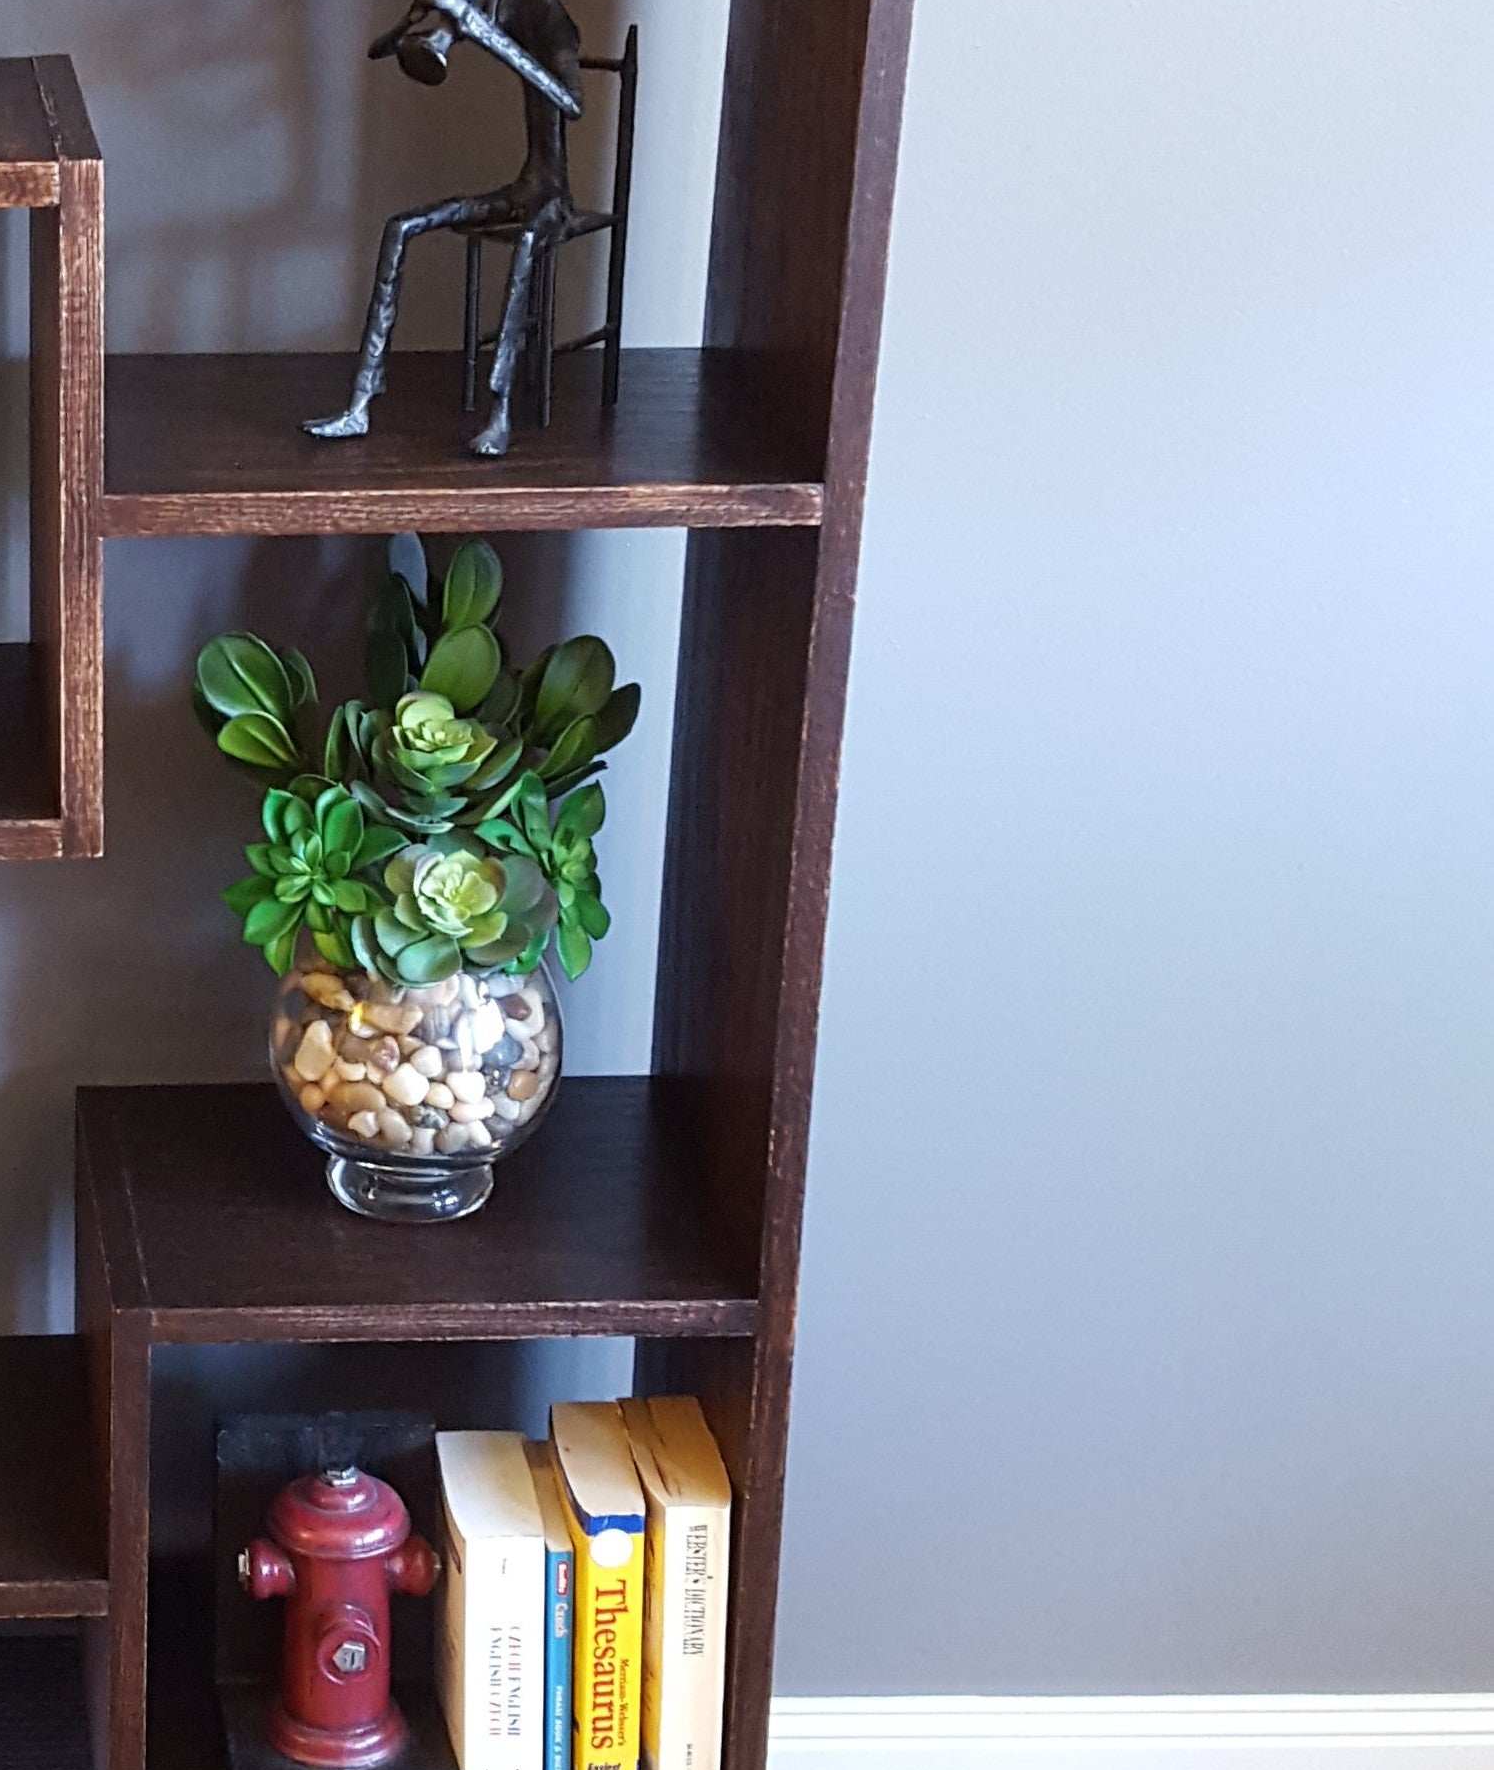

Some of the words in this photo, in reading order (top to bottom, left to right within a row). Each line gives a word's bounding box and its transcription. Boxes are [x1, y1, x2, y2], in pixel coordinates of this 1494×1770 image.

[685, 1524, 713, 1584] WEBSTER'S
[683, 1589, 707, 1657] DICTIONARY
[591, 1579, 629, 1749] Thesaurus
